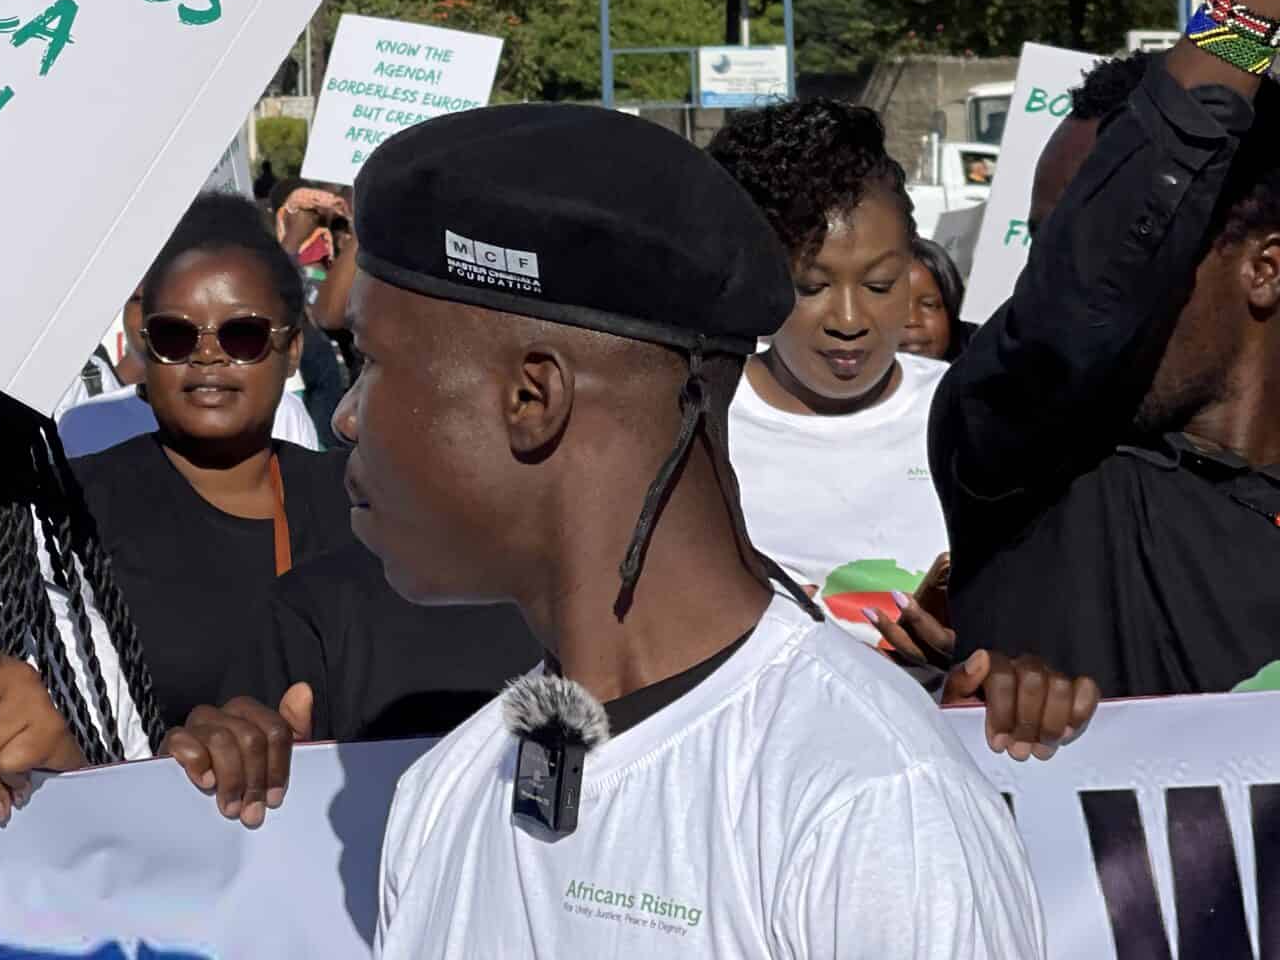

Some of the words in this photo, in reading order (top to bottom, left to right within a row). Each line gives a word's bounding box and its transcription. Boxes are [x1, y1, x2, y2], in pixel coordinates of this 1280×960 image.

[375, 40, 419, 57] KNOW
[424, 46, 455, 62] THE
[373, 61, 442, 85] AGENDA!
[327, 77, 420, 104] BORDERLESS
[352, 104, 381, 123] BUT
[345, 126, 389, 145] AFRIC
[447, 265, 543, 294] FOUNDATION
[565, 879, 635, 909] Africans
[640, 892, 702, 927] Rising
